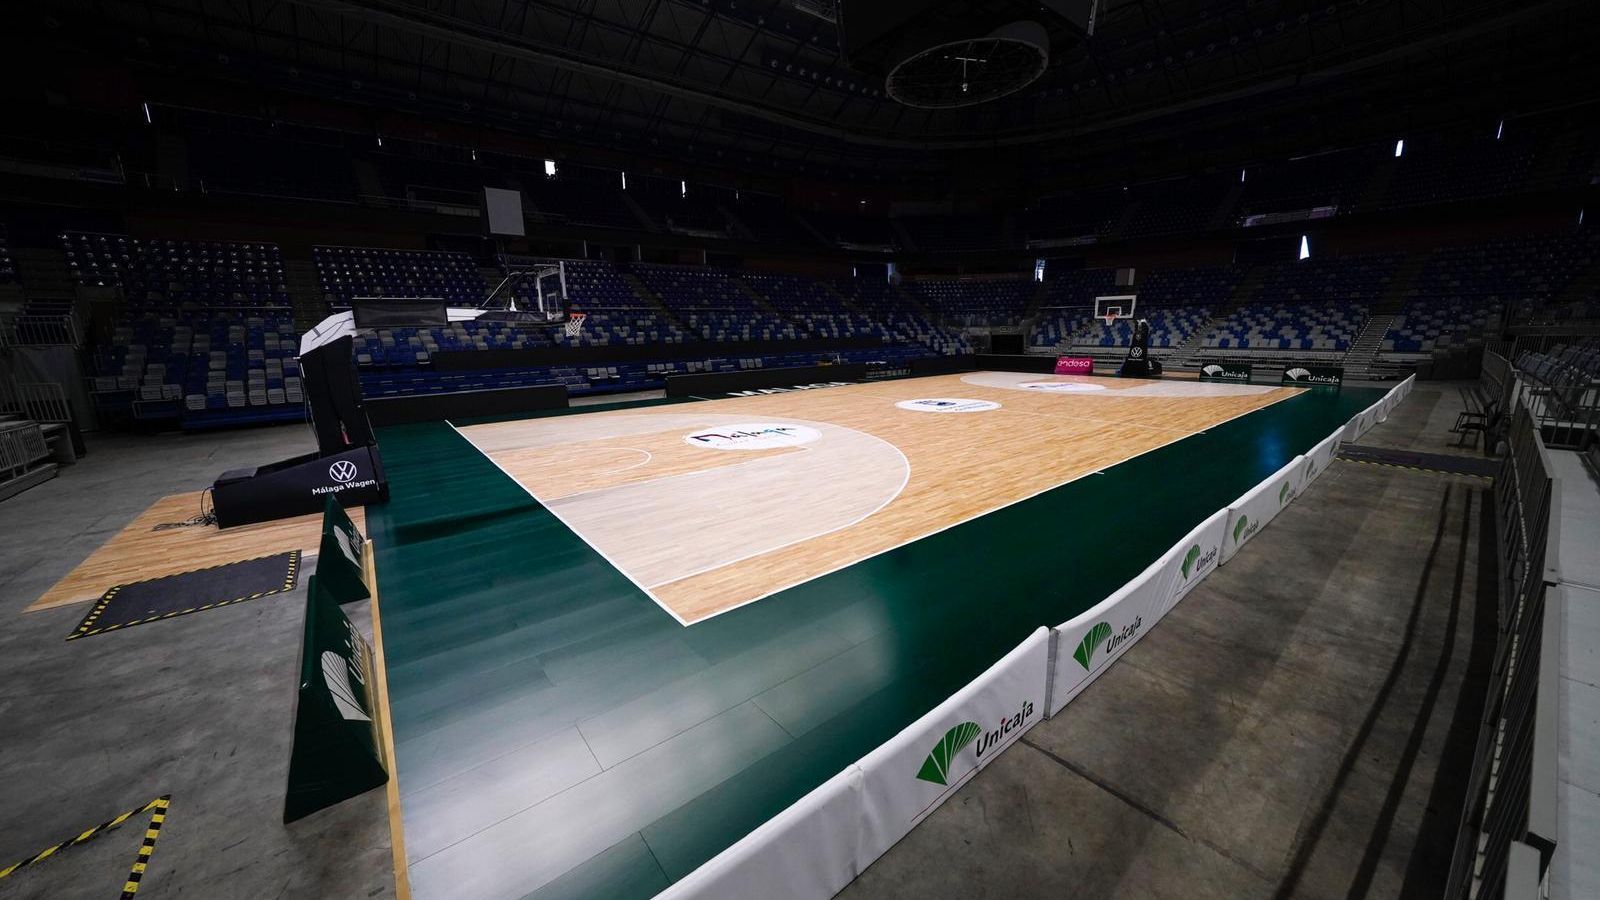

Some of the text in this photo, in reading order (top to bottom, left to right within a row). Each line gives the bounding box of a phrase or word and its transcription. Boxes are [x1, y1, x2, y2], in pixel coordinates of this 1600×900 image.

[1221, 371, 1249, 379] Unicaja
[1307, 375, 1340, 383] Unicaja
[312, 479, 376, 496] Málaga Wagen
[1106, 615, 1142, 654] Unicaja
[976, 700, 1034, 757] Unicaja
